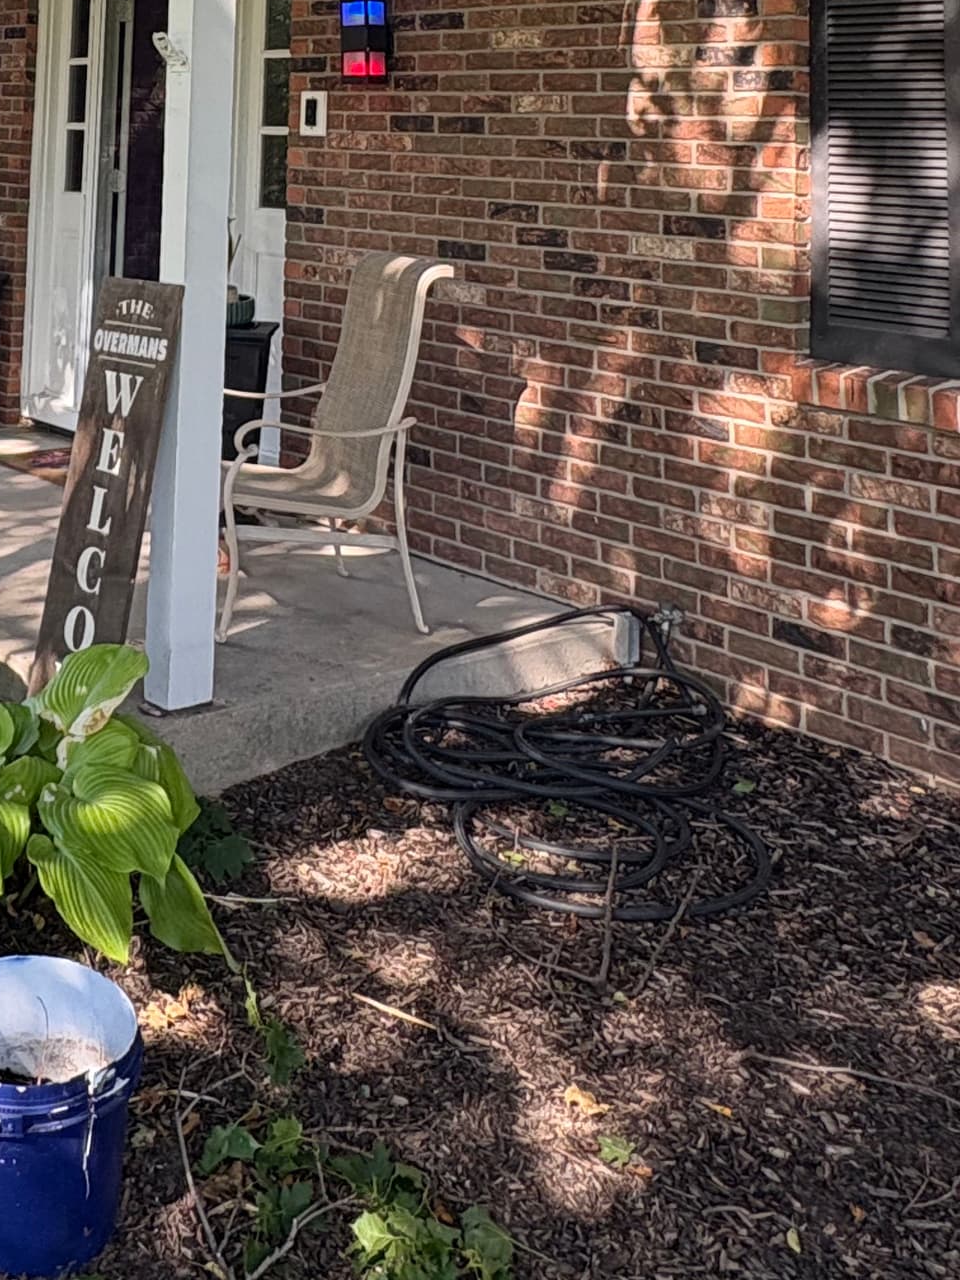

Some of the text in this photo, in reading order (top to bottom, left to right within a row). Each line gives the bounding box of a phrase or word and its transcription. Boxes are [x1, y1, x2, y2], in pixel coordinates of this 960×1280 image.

[118, 299, 154, 319] THE
[94, 328, 168, 361] OVERMANS
[55, 370, 144, 668] WELCO
